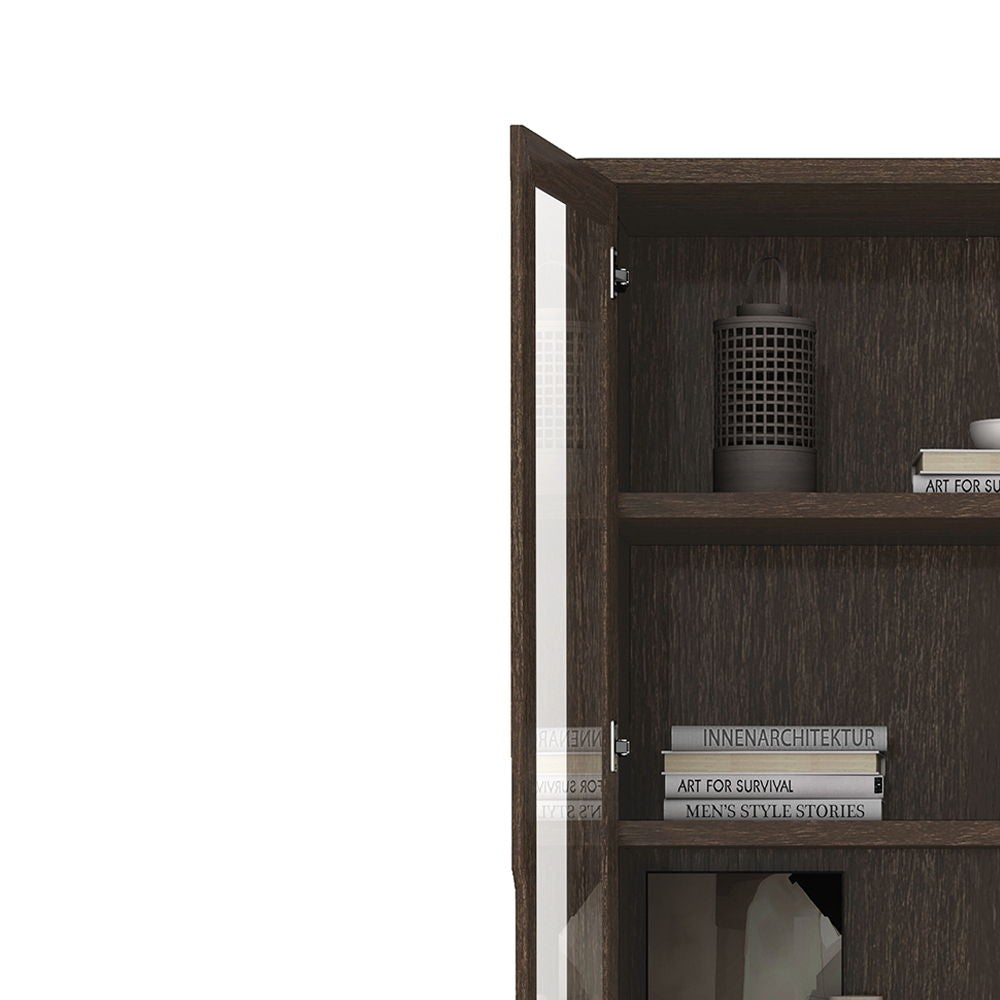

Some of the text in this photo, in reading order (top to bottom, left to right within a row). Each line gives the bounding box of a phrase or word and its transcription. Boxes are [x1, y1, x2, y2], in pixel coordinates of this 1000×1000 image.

[925, 479, 949, 493] ART
[955, 479, 980, 493] FOR
[703, 728, 875, 748] INNENARCHITEKTUR
[677, 779, 794, 793] ART FOR SURVIVAL
[686, 804, 865, 819] MEN'S STYLE STORIES
